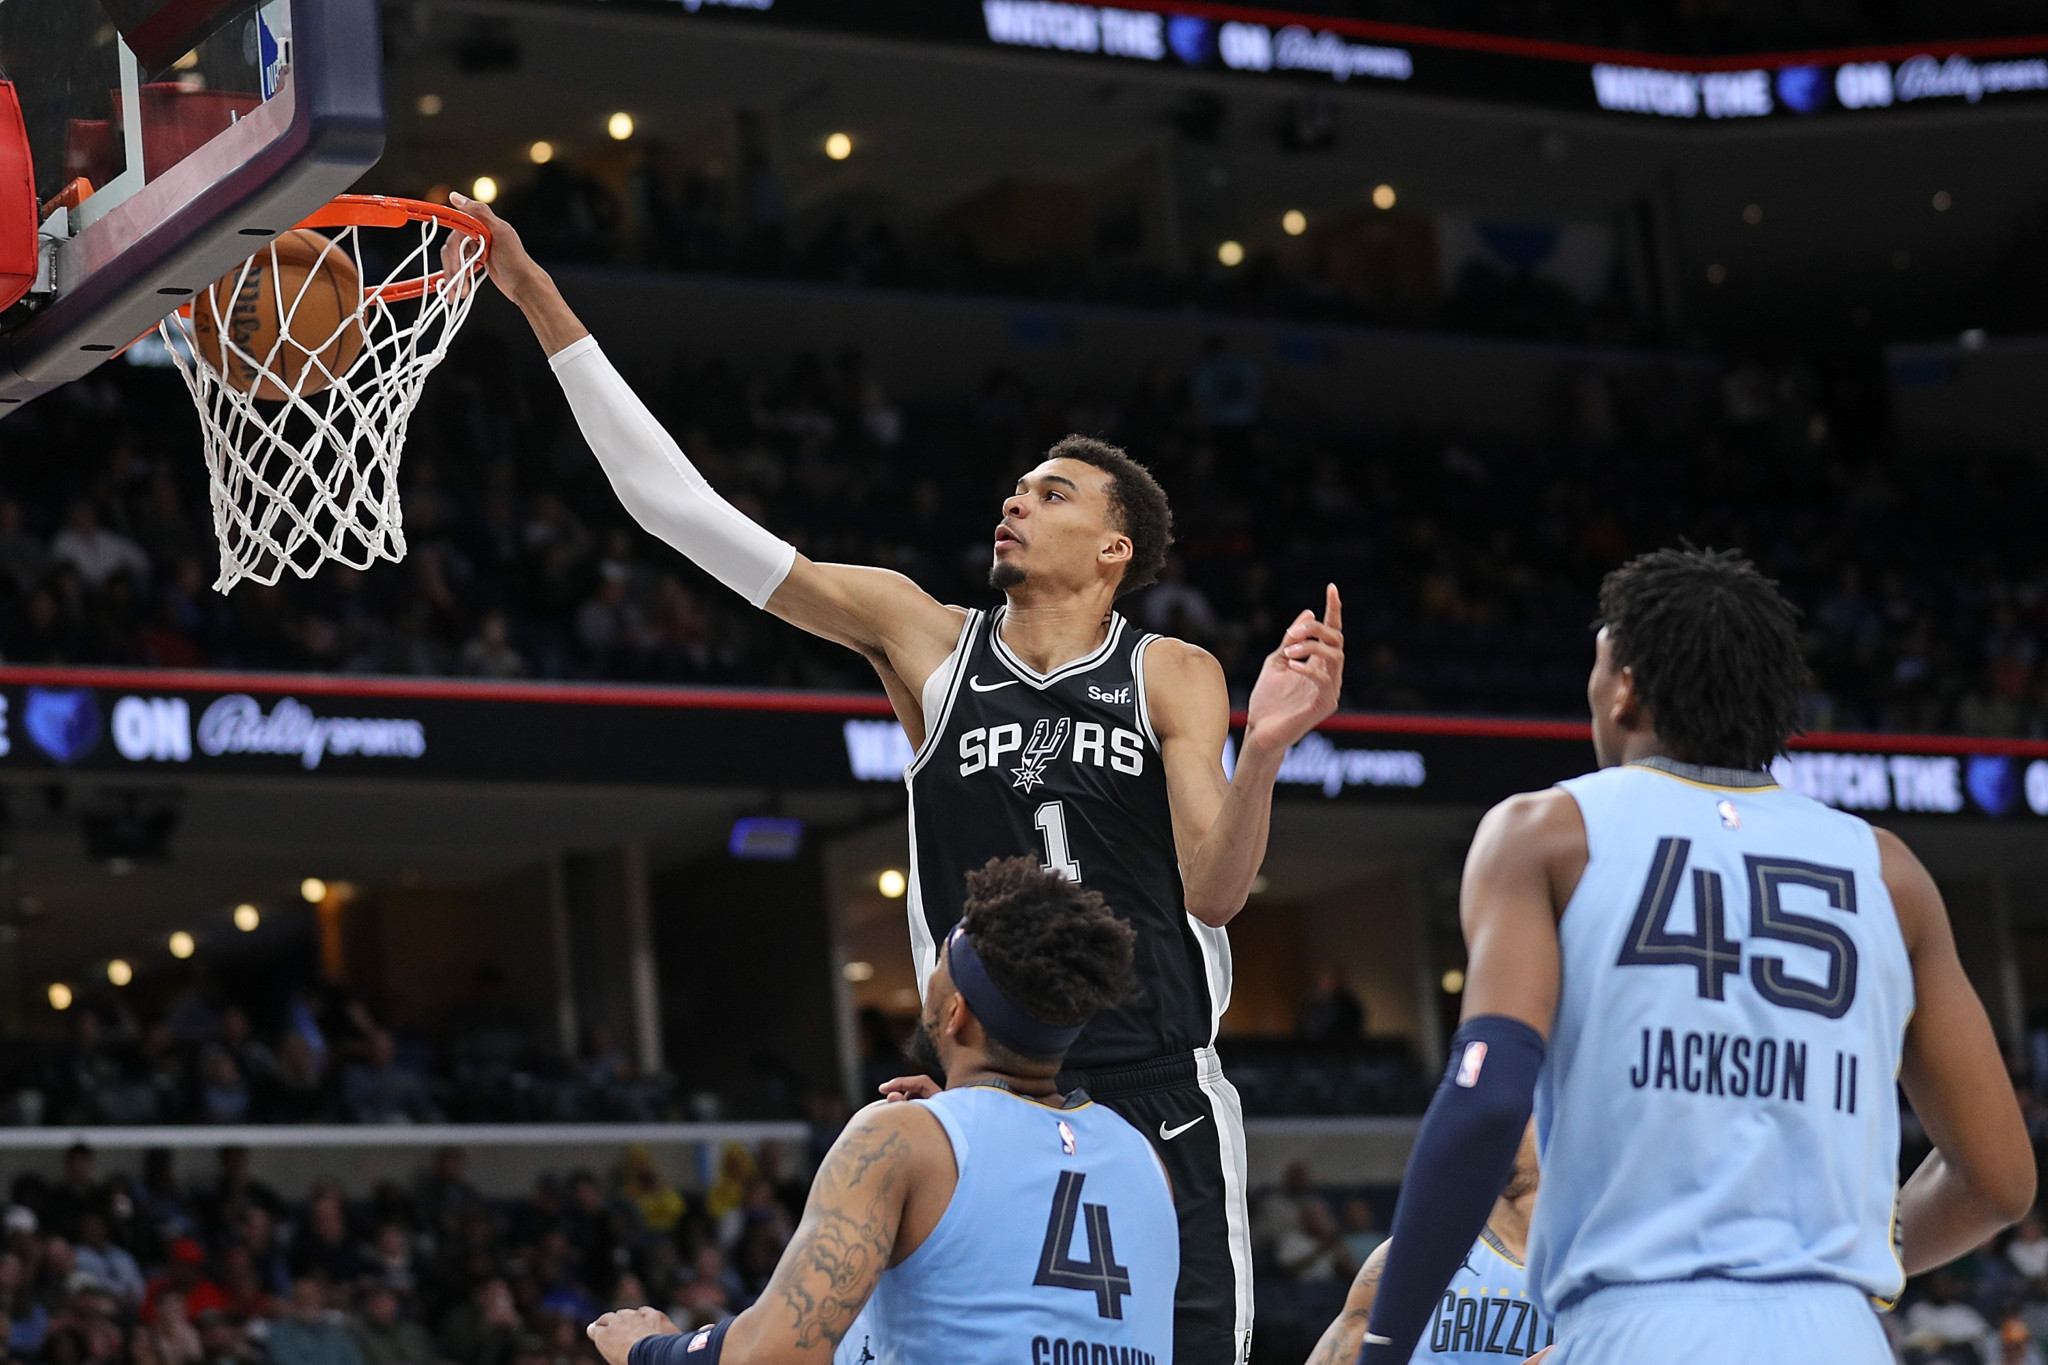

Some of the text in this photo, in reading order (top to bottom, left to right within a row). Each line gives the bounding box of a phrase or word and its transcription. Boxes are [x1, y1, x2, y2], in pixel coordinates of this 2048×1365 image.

[112, 695, 193, 763] ON
[1034, 800, 1082, 883] 1
[1616, 836, 1859, 1020] 45
[1630, 1028, 1857, 1115] JACKSON II
[1033, 1170, 1132, 1320] 4
[1032, 1335, 1156, 1365] GOOD
